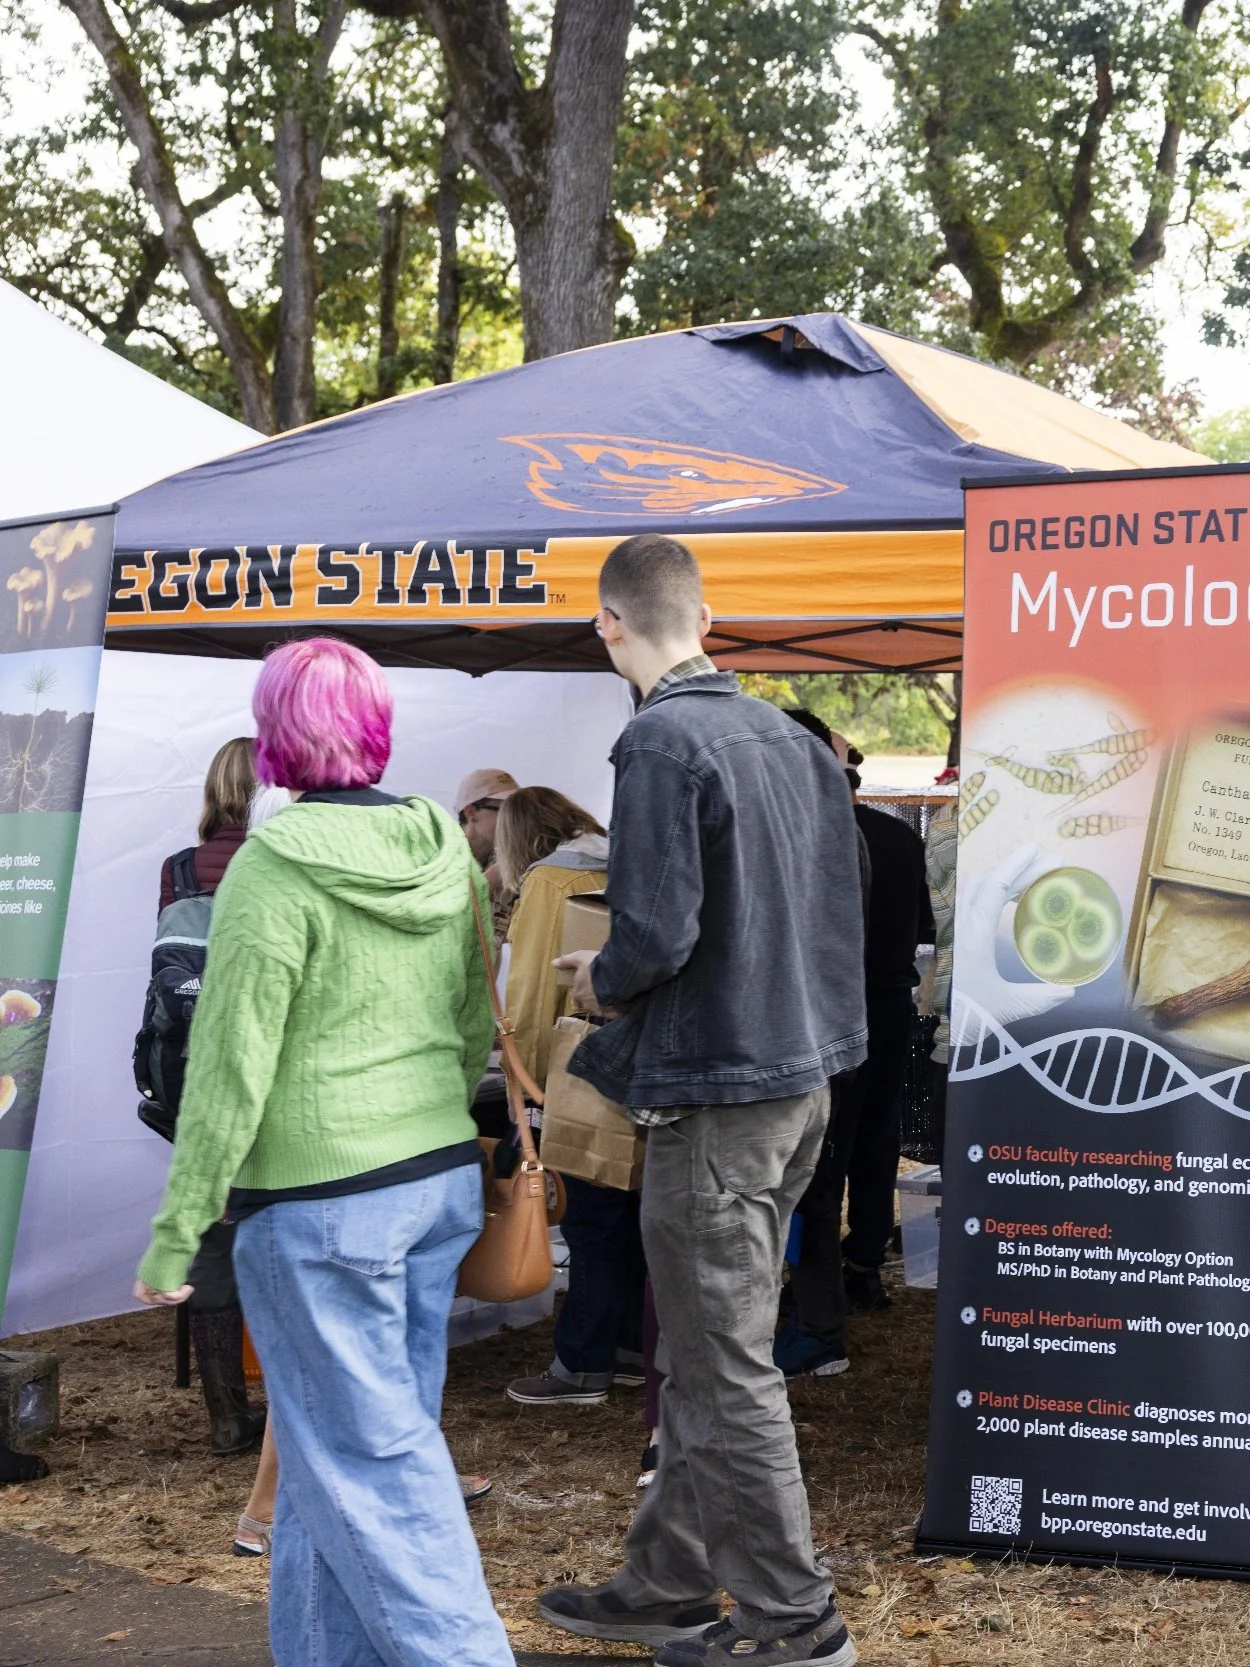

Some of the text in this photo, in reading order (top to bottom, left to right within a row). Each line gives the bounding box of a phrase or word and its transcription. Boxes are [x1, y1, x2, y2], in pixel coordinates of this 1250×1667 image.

[989, 513, 1139, 553] OREGON
[314, 538, 549, 607] STATE
[1194, 805, 1205, 816] J.
[1192, 821, 1243, 841] No. 1349
[14, 852, 41, 867] make
[1188, 841, 1228, 860] Oregon,
[16, 875, 56, 892] cheese,
[24, 899, 43, 914] like
[988, 1146, 1022, 1161] OSU
[1025, 1145, 1079, 1167] faculty
[1082, 1149, 1173, 1171] researching
[1176, 1151, 1228, 1172] fungal
[987, 1169, 1065, 1190] evolution,
[1068, 1173, 1151, 1195] pathology,
[1153, 1176, 1184, 1193] and
[985, 1218, 1112, 1239] Degrees offered:
[998, 1242, 1234, 1269] BS in Botany with Mycology Option
[997, 1262, 1051, 1278] MS/PhD
[1054, 1264, 1067, 1279] in
[1070, 1266, 1117, 1285] Botany
[1120, 1269, 1146, 1284] and
[1149, 1270, 1185, 1286] Plant
[982, 1307, 1034, 1327] Fungal
[1038, 1310, 1123, 1331] Herbarium
[1126, 1315, 1162, 1333] with
[1166, 1321, 1203, 1336] over
[981, 1330, 1117, 1355] fungal specimens
[978, 1391, 1020, 1409] Plant
[1023, 1395, 1083, 1414] Disease
[1087, 1398, 1131, 1418] Clinic
[1134, 1401, 1216, 1424] diagnoses
[976, 1416, 1020, 1434] 2,000
[1024, 1419, 1066, 1437] plant
[1068, 1421, 1128, 1442] disease
[1131, 1427, 1199, 1448] samples
[1042, 1488, 1088, 1507] Learn
[1091, 1494, 1135, 1511] more
[1138, 1497, 1169, 1515] and
[1173, 1501, 1200, 1519] get
[1040, 1512, 1207, 1542] bpp.oregonstate.edu
